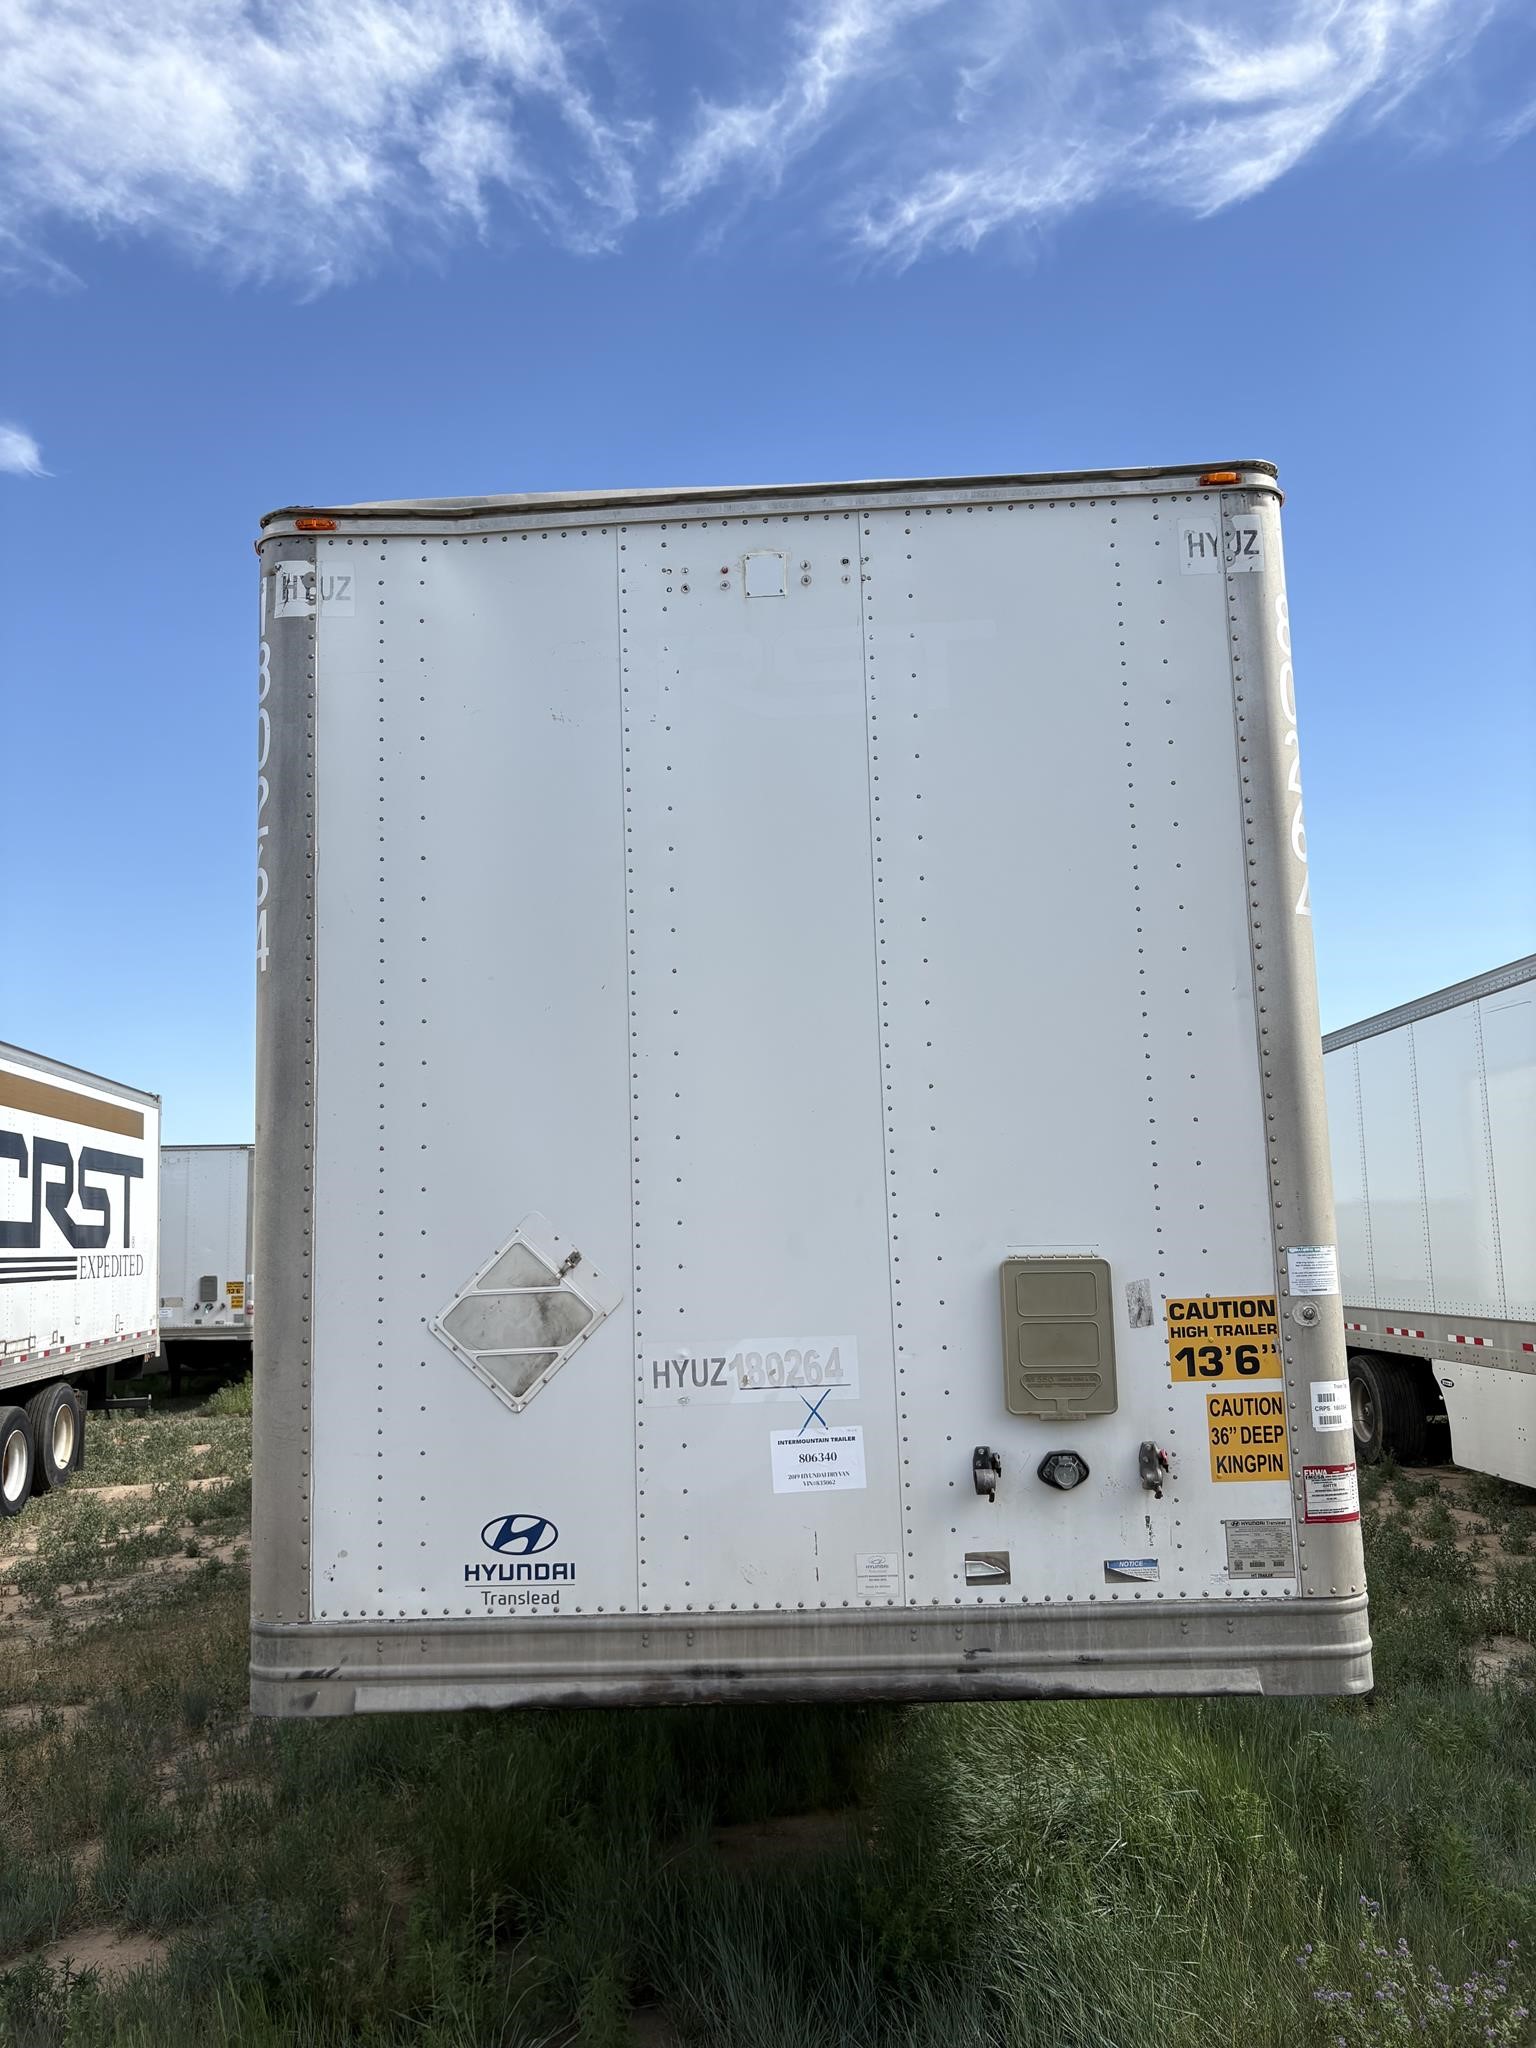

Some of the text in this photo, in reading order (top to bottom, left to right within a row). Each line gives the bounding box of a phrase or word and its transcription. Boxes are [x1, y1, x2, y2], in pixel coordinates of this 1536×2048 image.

[79, 1254, 144, 1280] EXPEDITED
[1168, 1300, 1276, 1320] CAUTION
[1170, 1323, 1278, 1338] HIGH TRAILER
[1209, 1397, 1283, 1417] CAUTION
[777, 1437, 830, 1446] INTERMOUNTAIN
[1240, 1425, 1284, 1444] DEEP
[798, 1451, 838, 1464] 806340
[1216, 1453, 1284, 1474] KINGPIN
[464, 1562, 576, 1582] HYUNDAI
[1119, 1560, 1144, 1568] NOTICE
[480, 1589, 560, 1606] Translead
